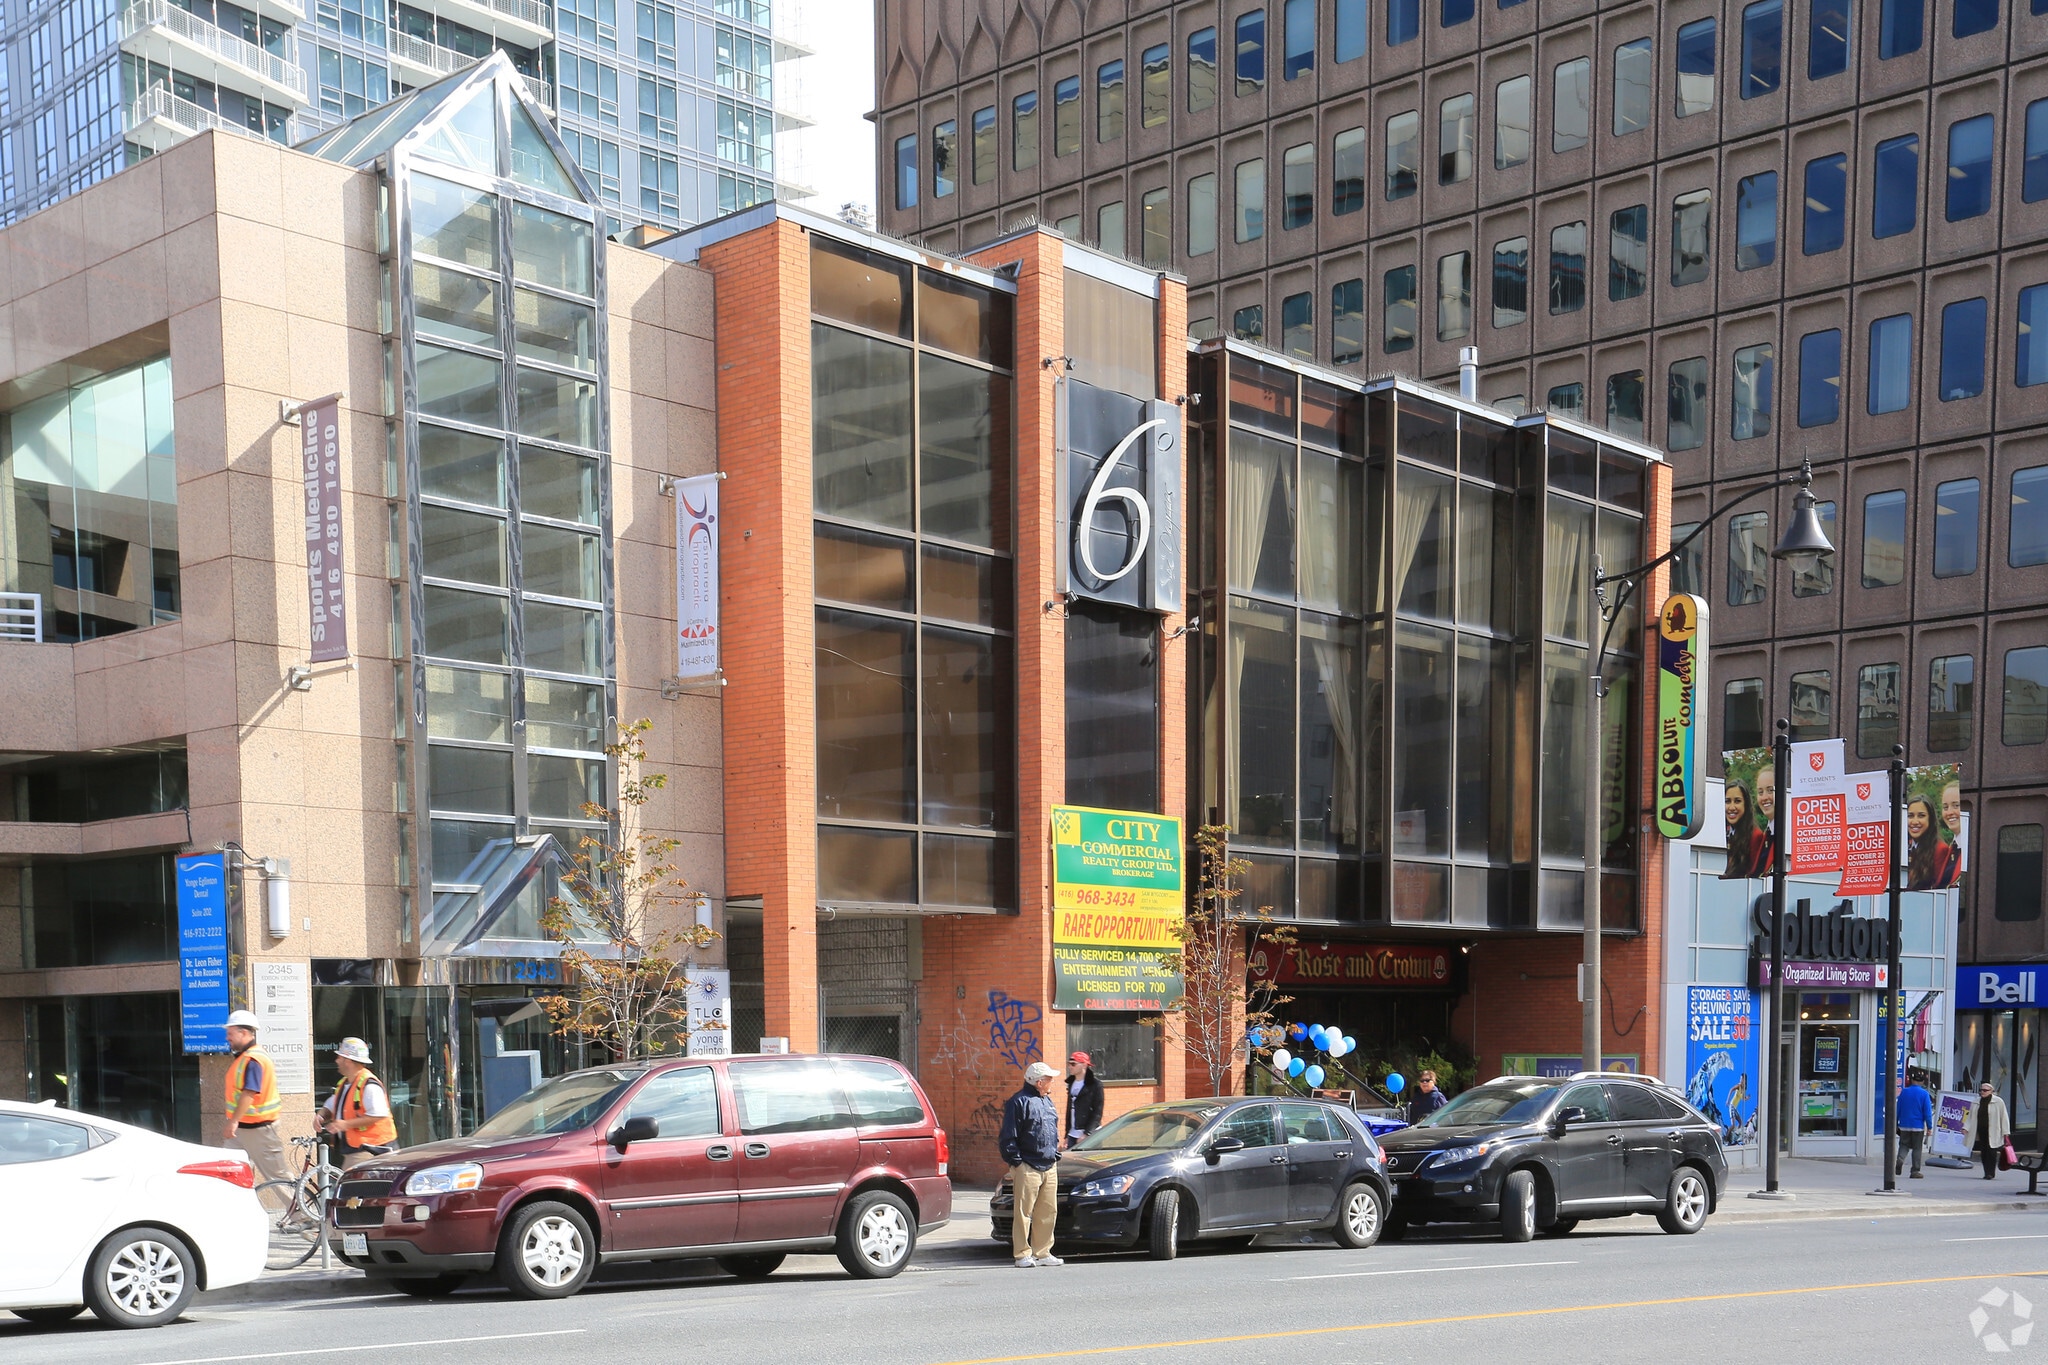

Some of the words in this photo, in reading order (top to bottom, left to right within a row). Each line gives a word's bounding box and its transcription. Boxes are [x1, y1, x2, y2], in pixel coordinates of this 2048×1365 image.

[324, 424, 337, 493] 1460
[304, 409, 320, 541] Medicine
[1080, 418, 1167, 581] 6
[326, 505, 339, 555] 480
[308, 549, 327, 642] Sports
[328, 568, 342, 618] 416
[1674, 649, 1696, 728] comedy
[1661, 717, 1688, 827] ABSOLUTE
[1797, 798, 1840, 814] OPEN
[1796, 813, 1840, 826] HOUSE
[1106, 820, 1160, 842] CITY
[1796, 828, 1830, 837] OCTOBER
[1846, 825, 1885, 840] OPEN
[1082, 841, 1174, 860] COMMERCIAL
[1847, 840, 1884, 851] HOUSE
[1082, 856, 1119, 867] REALTY
[1122, 859, 1154, 870] GROUP
[1796, 854, 1838, 862] SCS.ON.CA
[1112, 869, 1154, 878] BROKERAGE
[1845, 875, 1882, 883] SCS.ON.CA
[194, 889, 208, 898] Dental
[1076, 889, 1135, 907] 968-3434
[184, 926, 222, 938] 416-932-2222
[1063, 912, 1093, 938] RARE
[1755, 892, 1902, 960] Solution
[195, 958, 207, 967] Leon
[208, 957, 222, 966] Fisher
[1055, 949, 1080, 960] FULLY
[1081, 950, 1124, 962] SERVICED
[1126, 952, 1154, 964] 14,700
[1293, 948, 1341, 978] Rose
[1344, 950, 1375, 979] and
[1378, 950, 1432, 980] Crown
[268, 964, 292, 974] 2345
[515, 961, 557, 979] 2345
[1062, 964, 1137, 977] ENTERTAINMENT
[1141, 966, 1174, 978] VENUE
[1786, 964, 1824, 984] Organized
[1826, 966, 1848, 985] Living
[1849, 967, 1870, 982] Store
[1077, 980, 1120, 992] LICENSED
[1125, 981, 1145, 993] FOR
[1150, 982, 1166, 993] 700
[1979, 972, 2036, 1003] Bell
[1733, 990, 1750, 1001] SAVE
[1084, 998, 1106, 1009] CALL
[1107, 999, 1125, 1009] FOR
[1126, 999, 1160, 1009] DETAILS
[1691, 1002, 1731, 1014] SHELVING
[1690, 1015, 1730, 1041] SALE
[696, 1035, 723, 1046] yonge
[262, 1044, 304, 1053] RICHTER
[692, 1046, 728, 1055] eglinton
